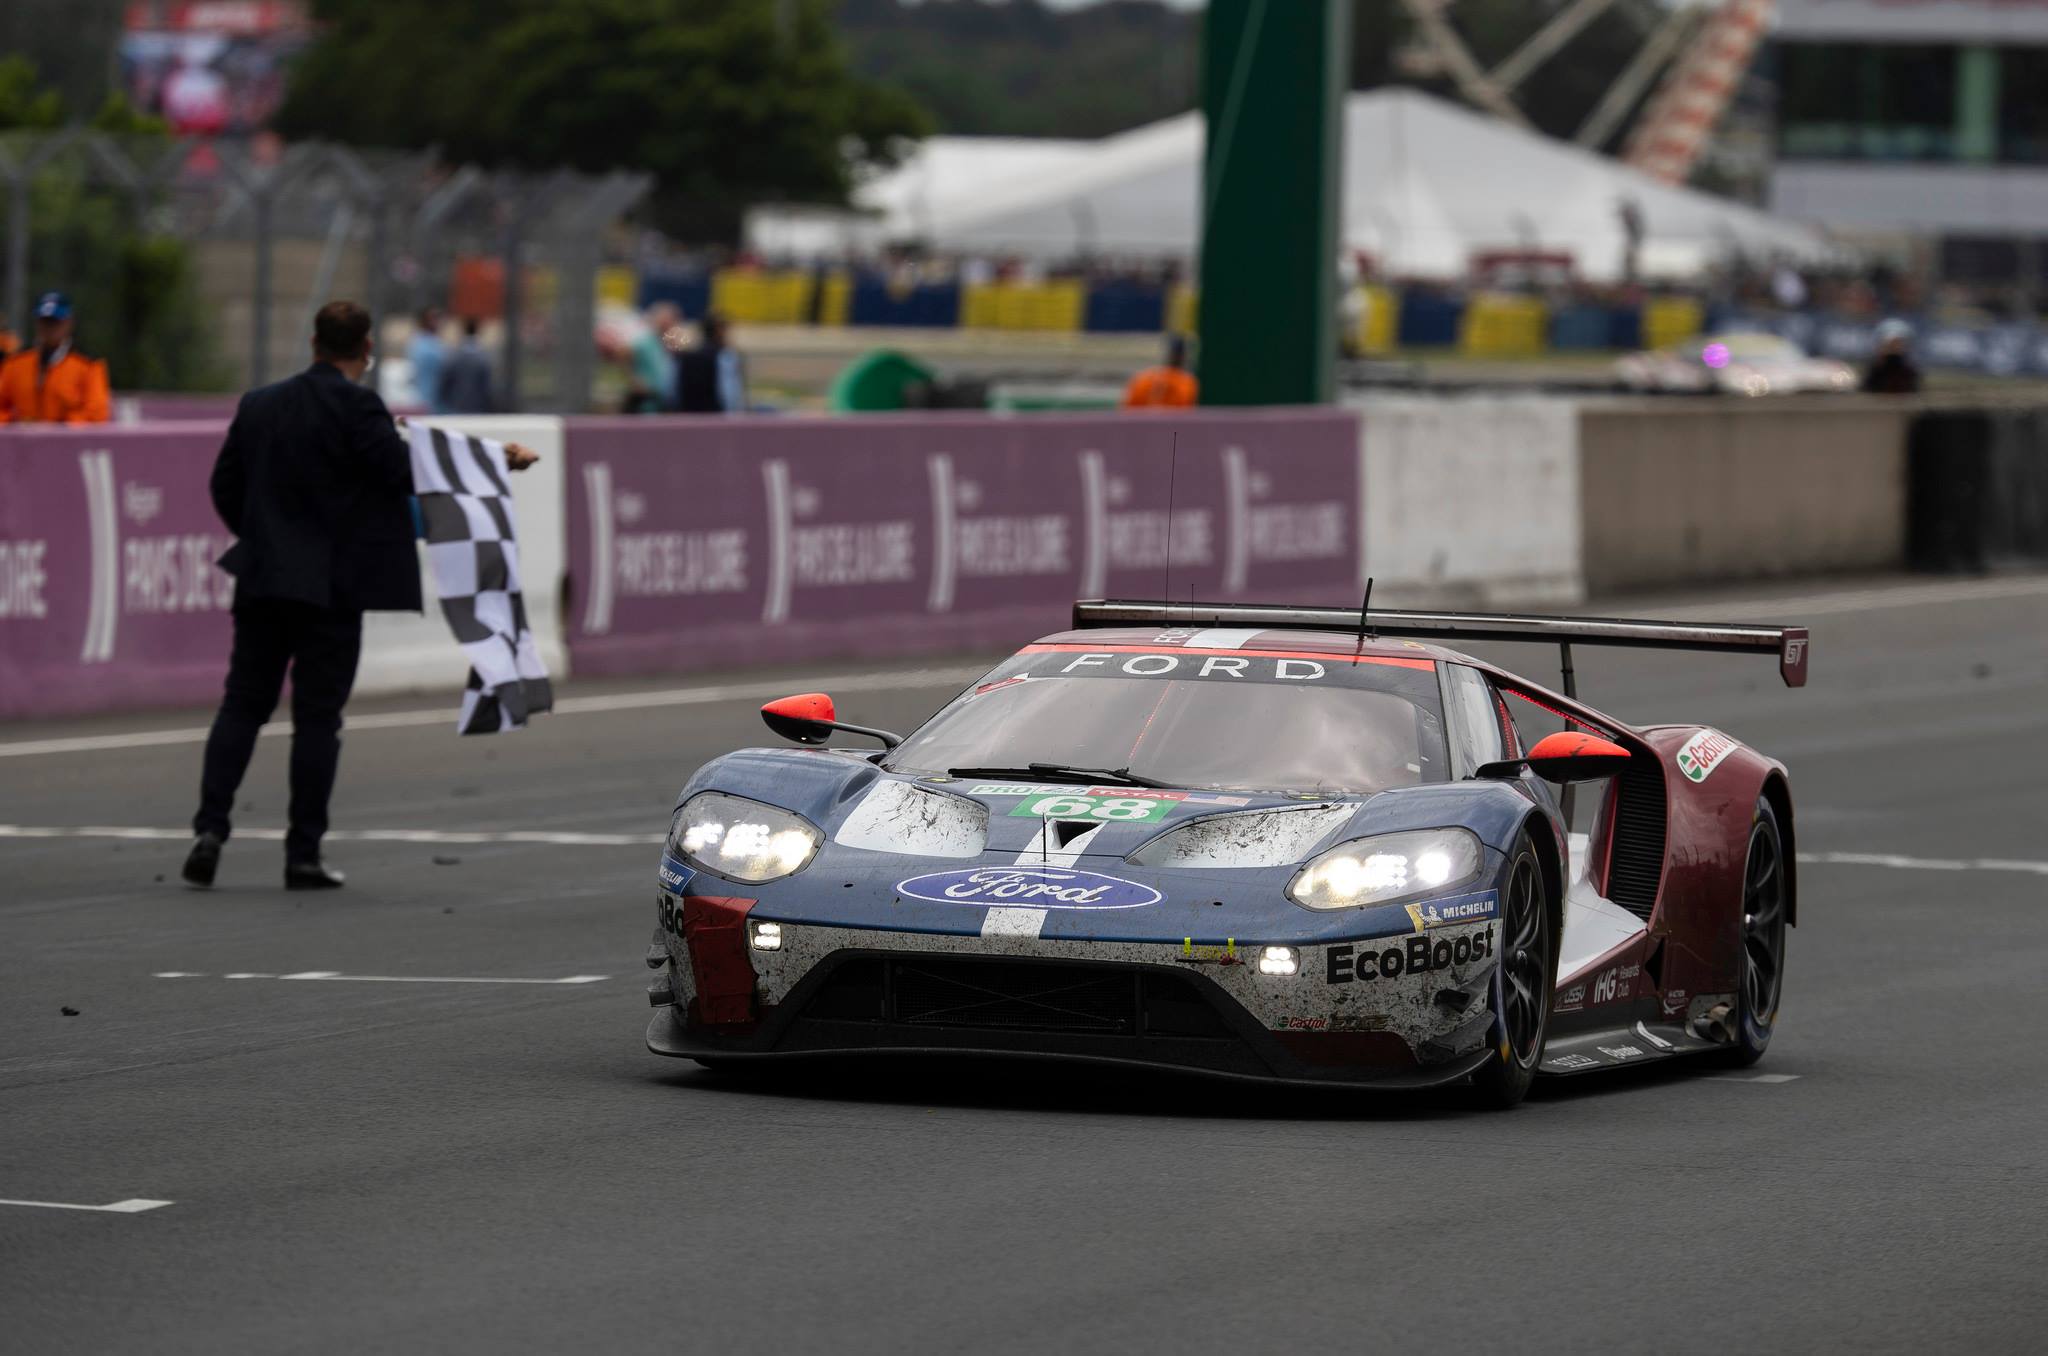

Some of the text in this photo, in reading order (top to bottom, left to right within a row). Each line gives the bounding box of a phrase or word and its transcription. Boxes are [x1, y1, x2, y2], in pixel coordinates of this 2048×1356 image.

[1785, 638, 1808, 666] GT
[1060, 653, 1325, 680] FORD
[974, 785, 1033, 795] PRO
[1095, 789, 1180, 800] TOTAL
[1030, 795, 1158, 820] 68
[944, 870, 1113, 903] Ford
[1443, 900, 1494, 919] MICHELIN
[1326, 922, 1494, 985] EcoBoost
[1594, 967, 1617, 1004] IHG
[1289, 1016, 1328, 1029] Castrol
